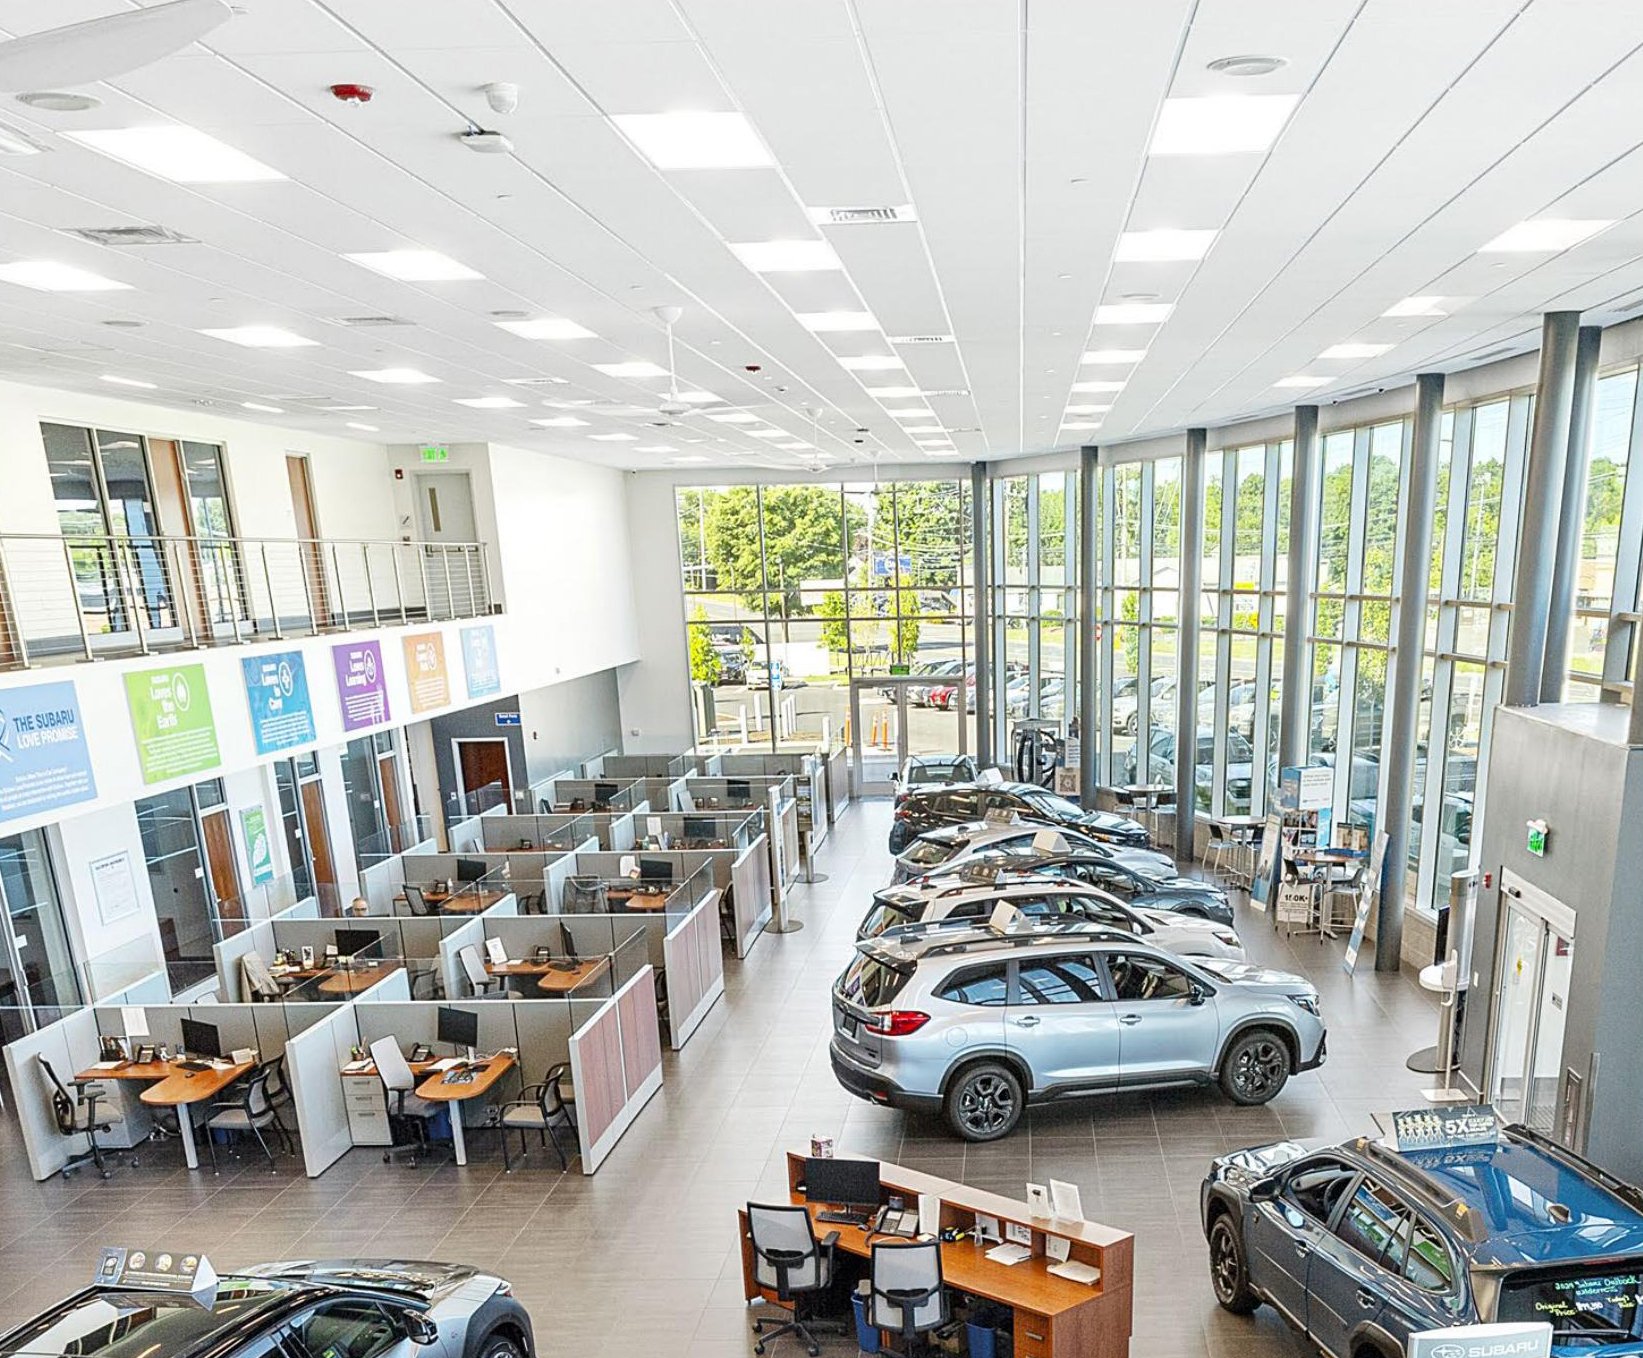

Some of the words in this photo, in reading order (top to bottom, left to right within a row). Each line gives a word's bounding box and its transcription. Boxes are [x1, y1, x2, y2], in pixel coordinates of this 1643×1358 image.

[13, 715, 35, 733] THE
[36, 709, 76, 730] SUBARU
[16, 730, 41, 750] LOVE
[41, 725, 80, 745] PROMISE
[1445, 1118, 1469, 1135] 5X
[1535, 1301, 1569, 1314] Original
[1467, 1340, 1539, 1358] SUBARU
